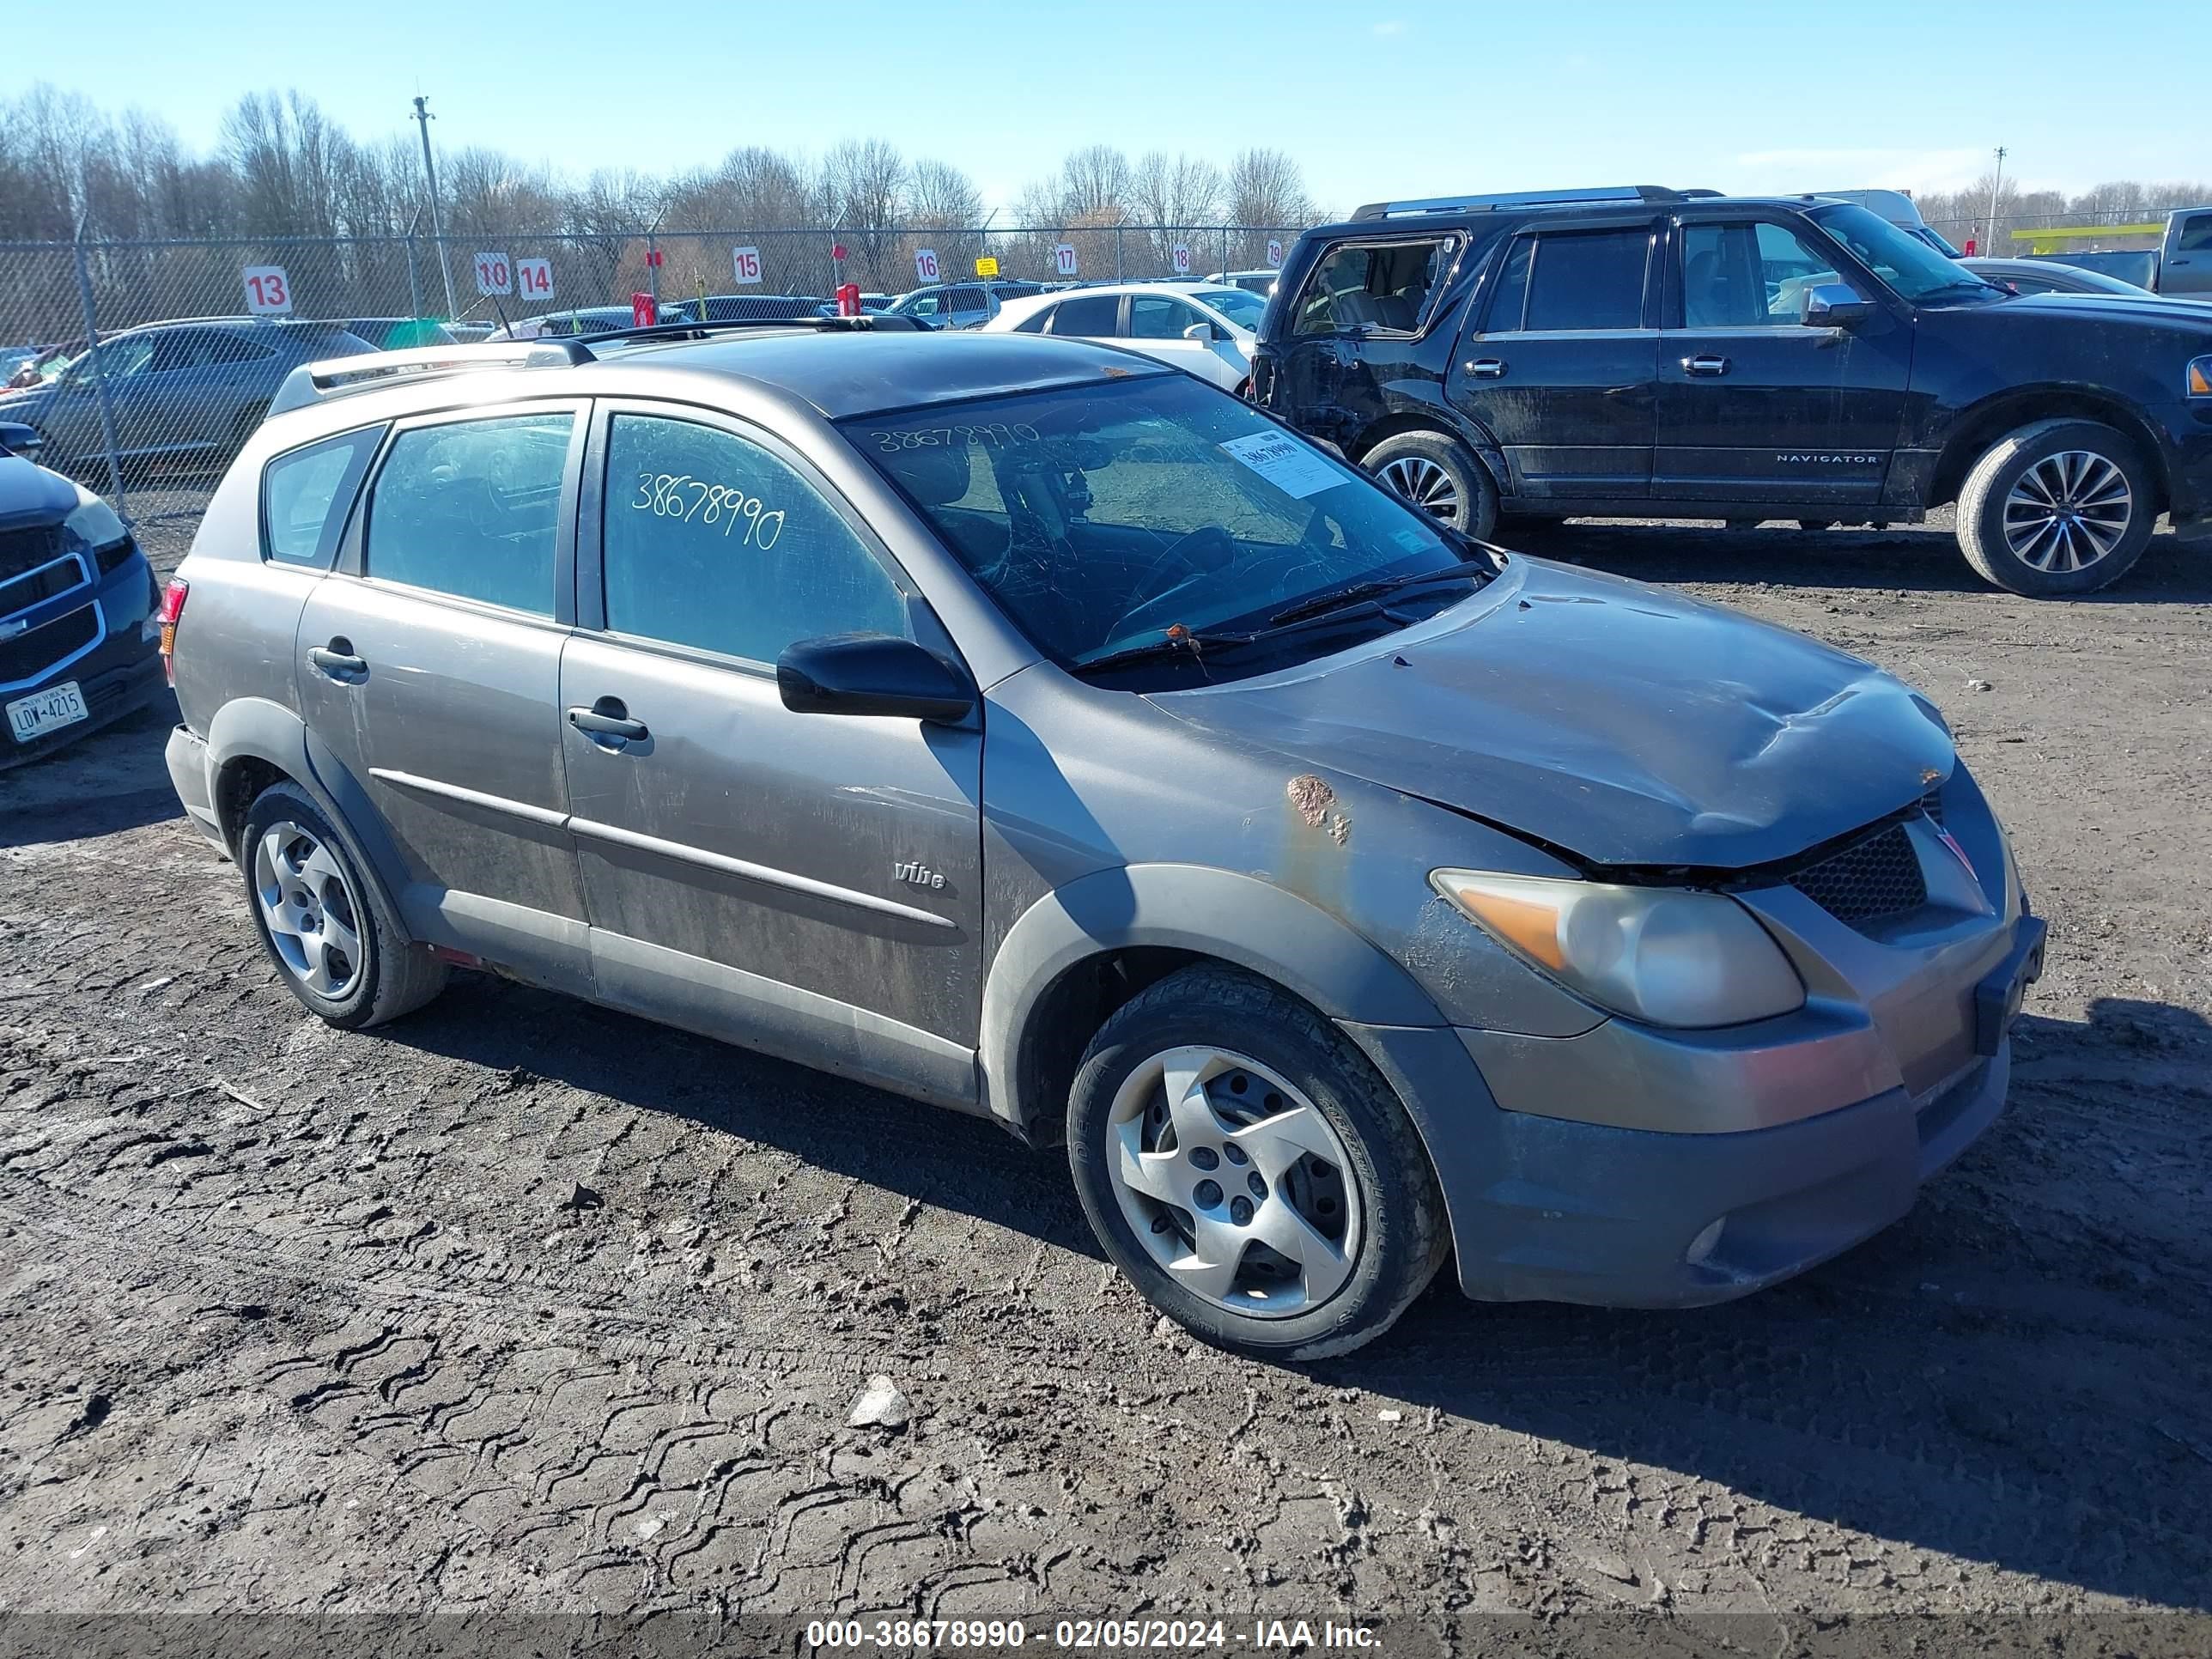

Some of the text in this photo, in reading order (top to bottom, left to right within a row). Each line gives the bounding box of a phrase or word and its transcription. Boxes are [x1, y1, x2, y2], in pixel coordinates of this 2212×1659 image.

[736, 254, 758, 277] 15
[918, 255, 936, 276] 16
[1059, 250, 1073, 269] 17
[1175, 250, 1188, 267] 18
[1270, 245, 1279, 262] 19
[480, 262, 507, 287] 10
[521, 266, 550, 293] 14
[248, 275, 286, 306] 13
[871, 423, 1039, 452] 38678990
[1242, 442, 1298, 465] 38678990
[632, 473, 785, 550] 38678990
[895, 860, 947, 890] vibe
